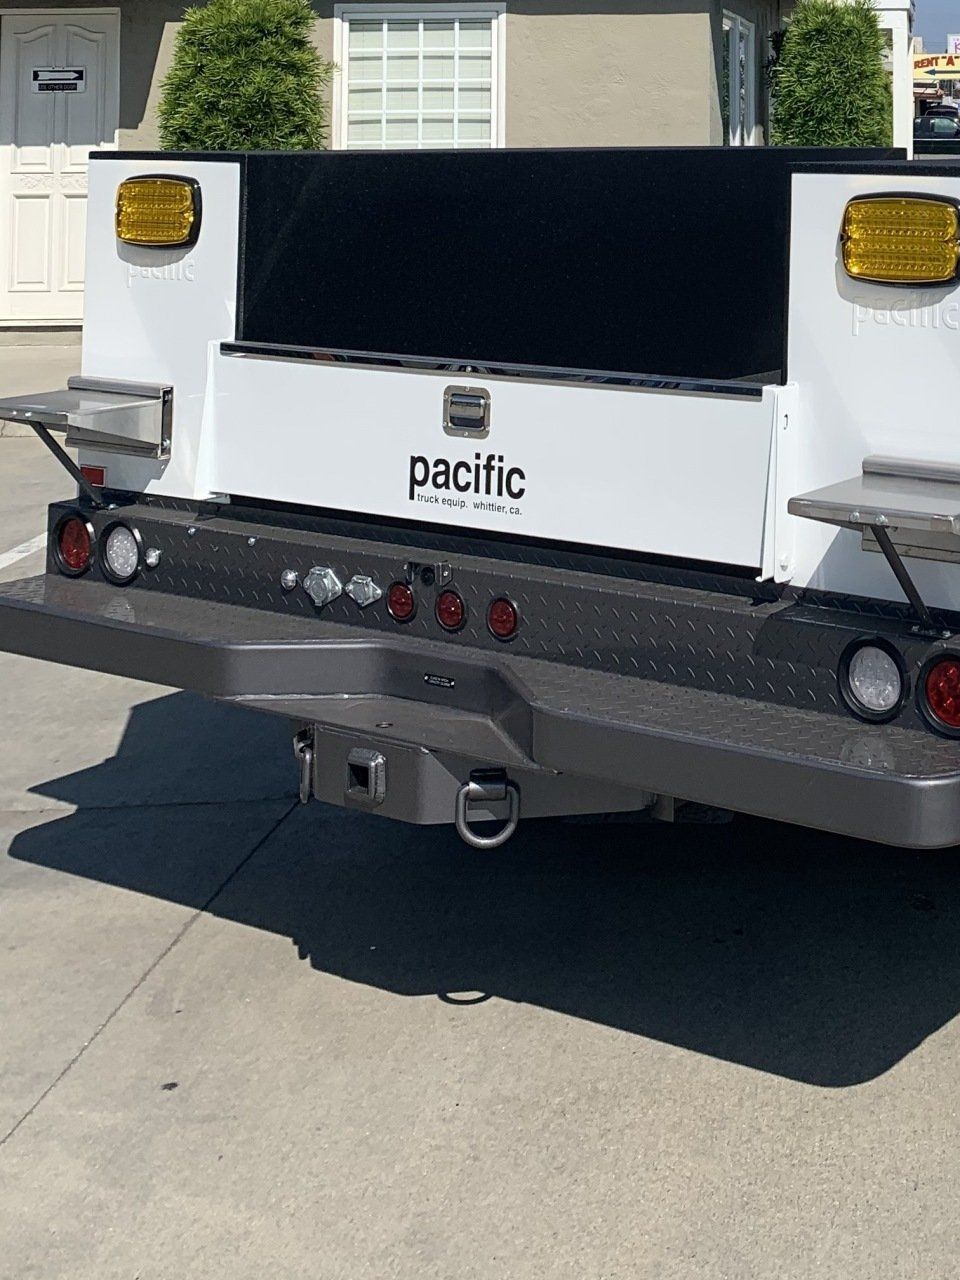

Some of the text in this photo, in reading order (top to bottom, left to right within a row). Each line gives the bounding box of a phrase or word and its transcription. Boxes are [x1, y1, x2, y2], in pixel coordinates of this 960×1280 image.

[914, 56, 939, 69] RENT
[408, 452, 526, 501] pacific
[417, 493, 523, 516] truck equip. whittier, ca.
